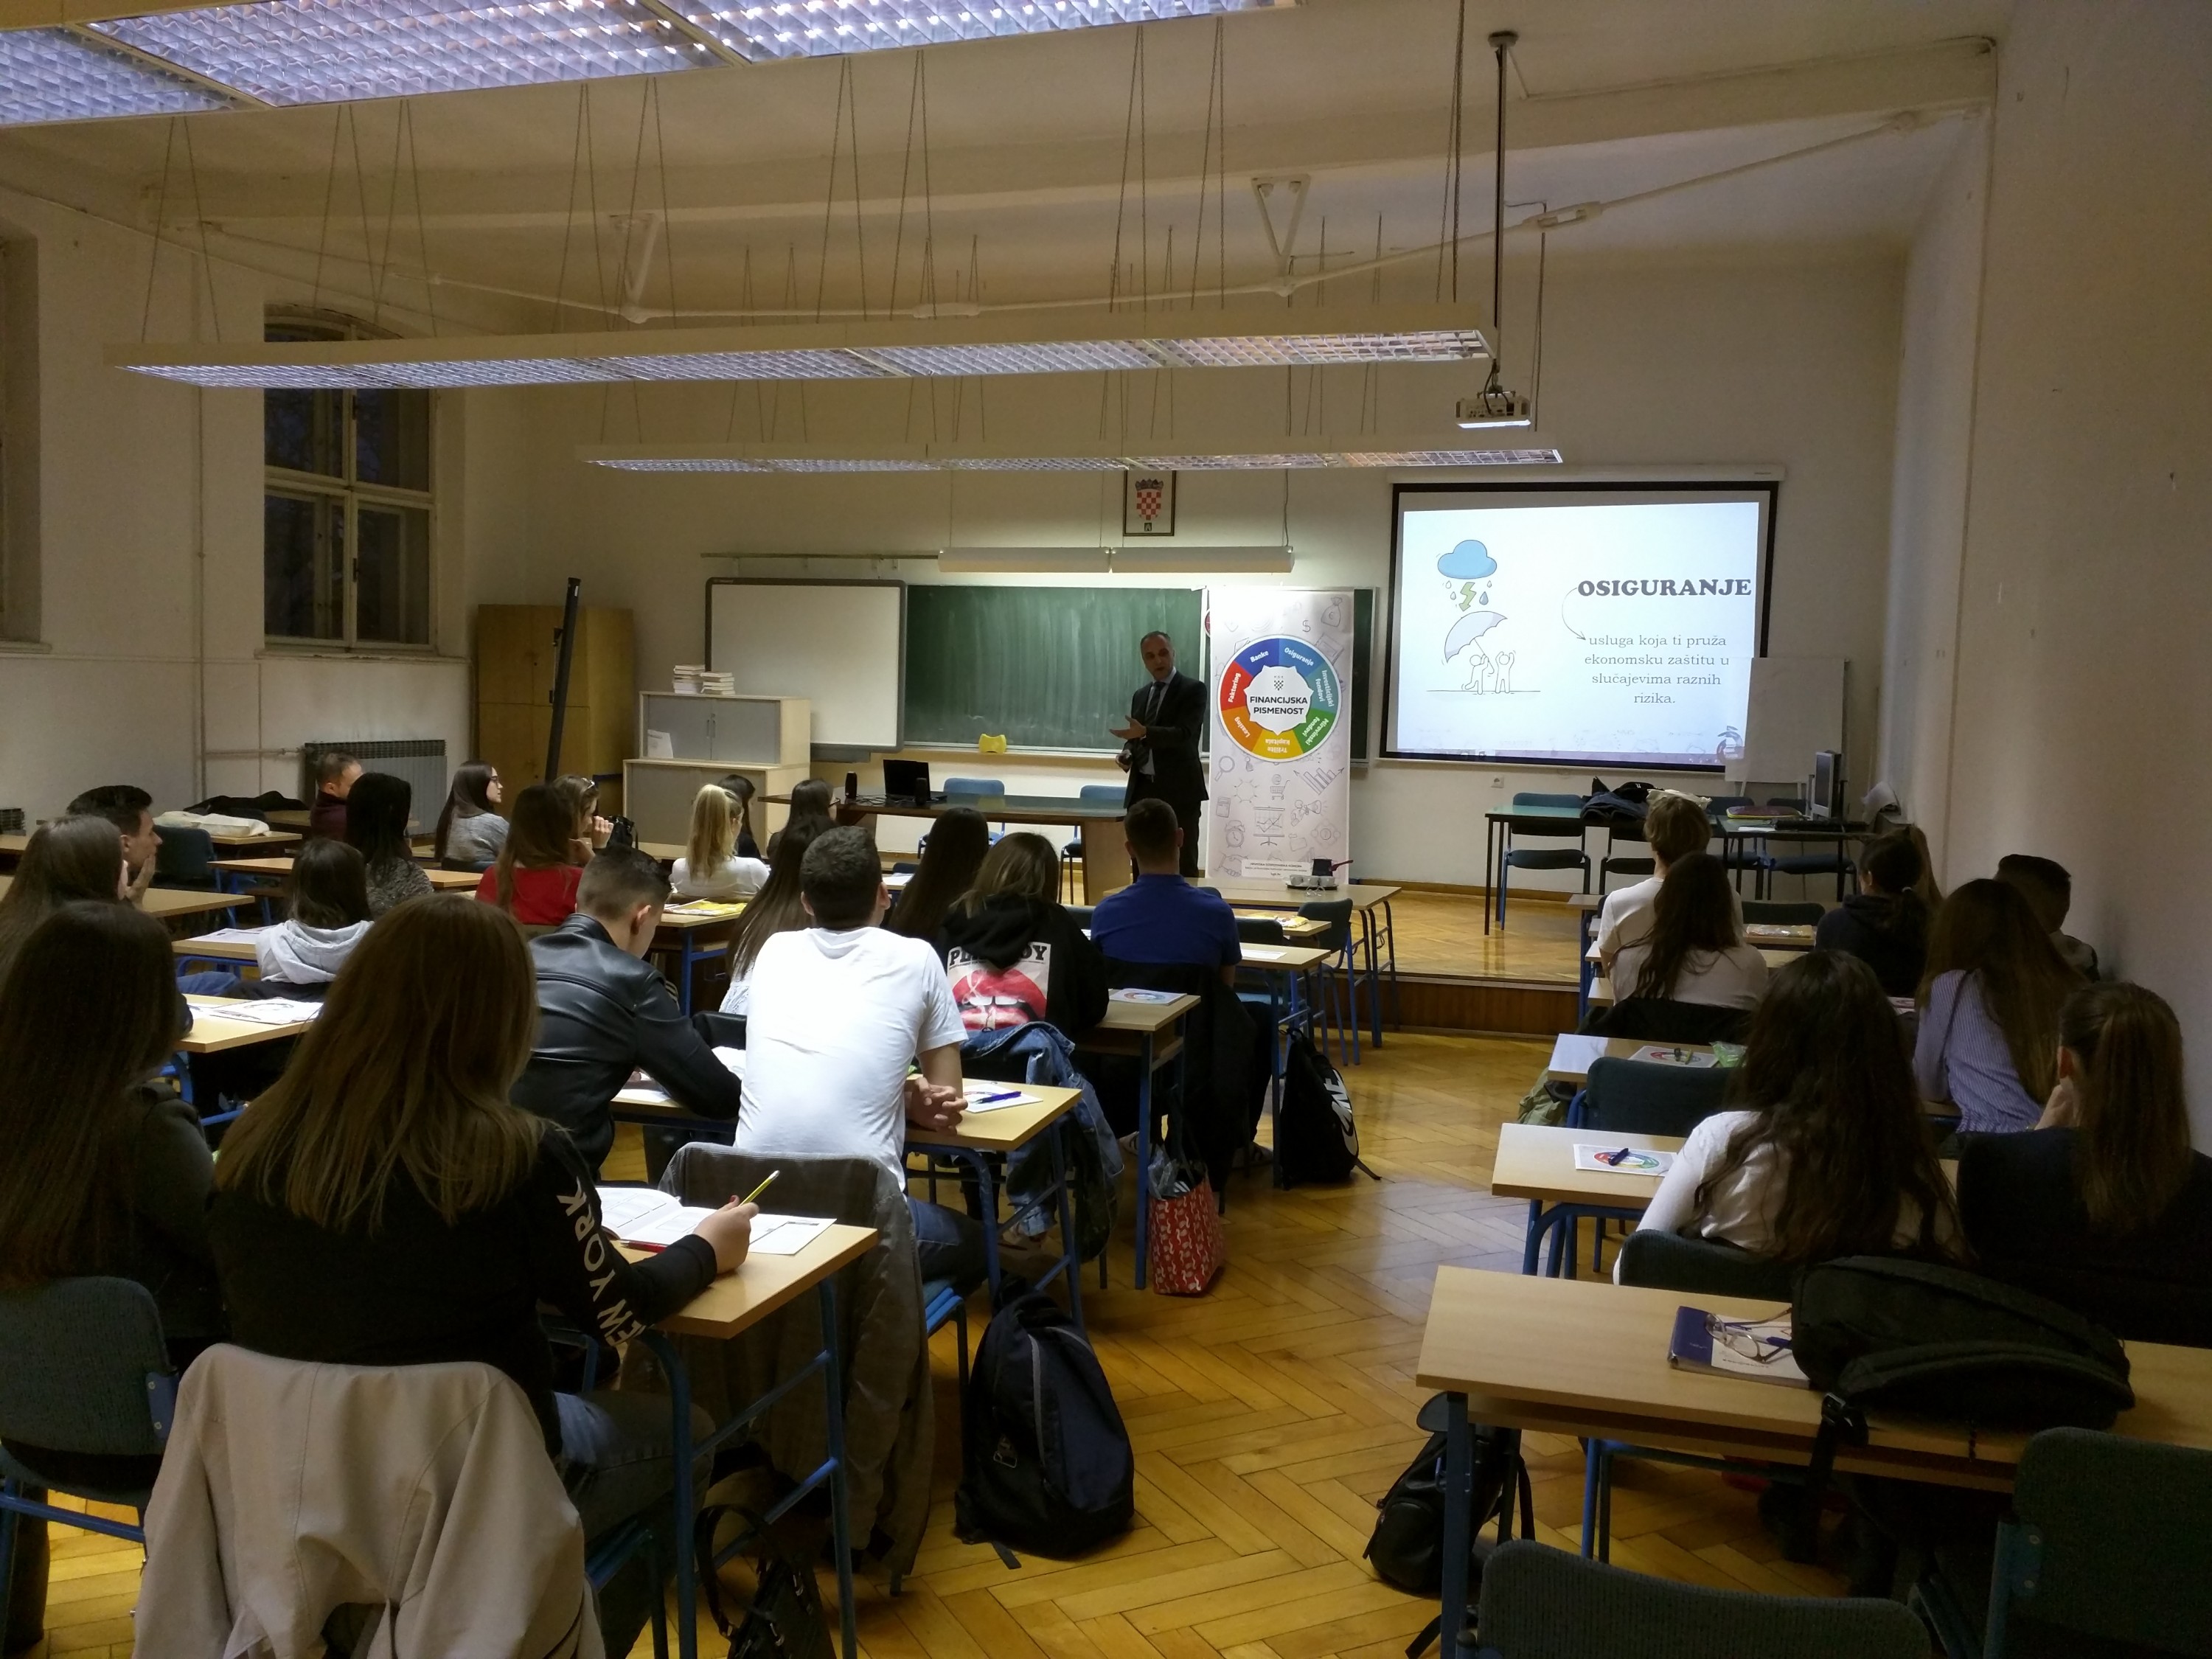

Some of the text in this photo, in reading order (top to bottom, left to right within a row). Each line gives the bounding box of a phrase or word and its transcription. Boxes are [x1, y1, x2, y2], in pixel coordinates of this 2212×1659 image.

[1578, 579, 1752, 597] OSIGURANJE
[1589, 634, 1727, 648] usluga koja ti pruža
[1250, 650, 1269, 663] Banke
[1284, 647, 1315, 667] Osiguranje
[1585, 654, 1730, 666] ekonomsku zaštitu u
[1228, 672, 1242, 703] Faktoring
[1592, 673, 1722, 686] slučajevima raznih
[1315, 678, 1326, 703] fondovi
[1634, 692, 1675, 704] rizika.
[1250, 696, 1308, 704] FINANCIJSKA
[1253, 707, 1304, 715] PISMENOST
[1234, 716, 1251, 738] Leasing
[1301, 717, 1321, 737] fondovi
[1304, 718, 1329, 746] Mirovinski
[556, 1176, 647, 1346] EW YORK
